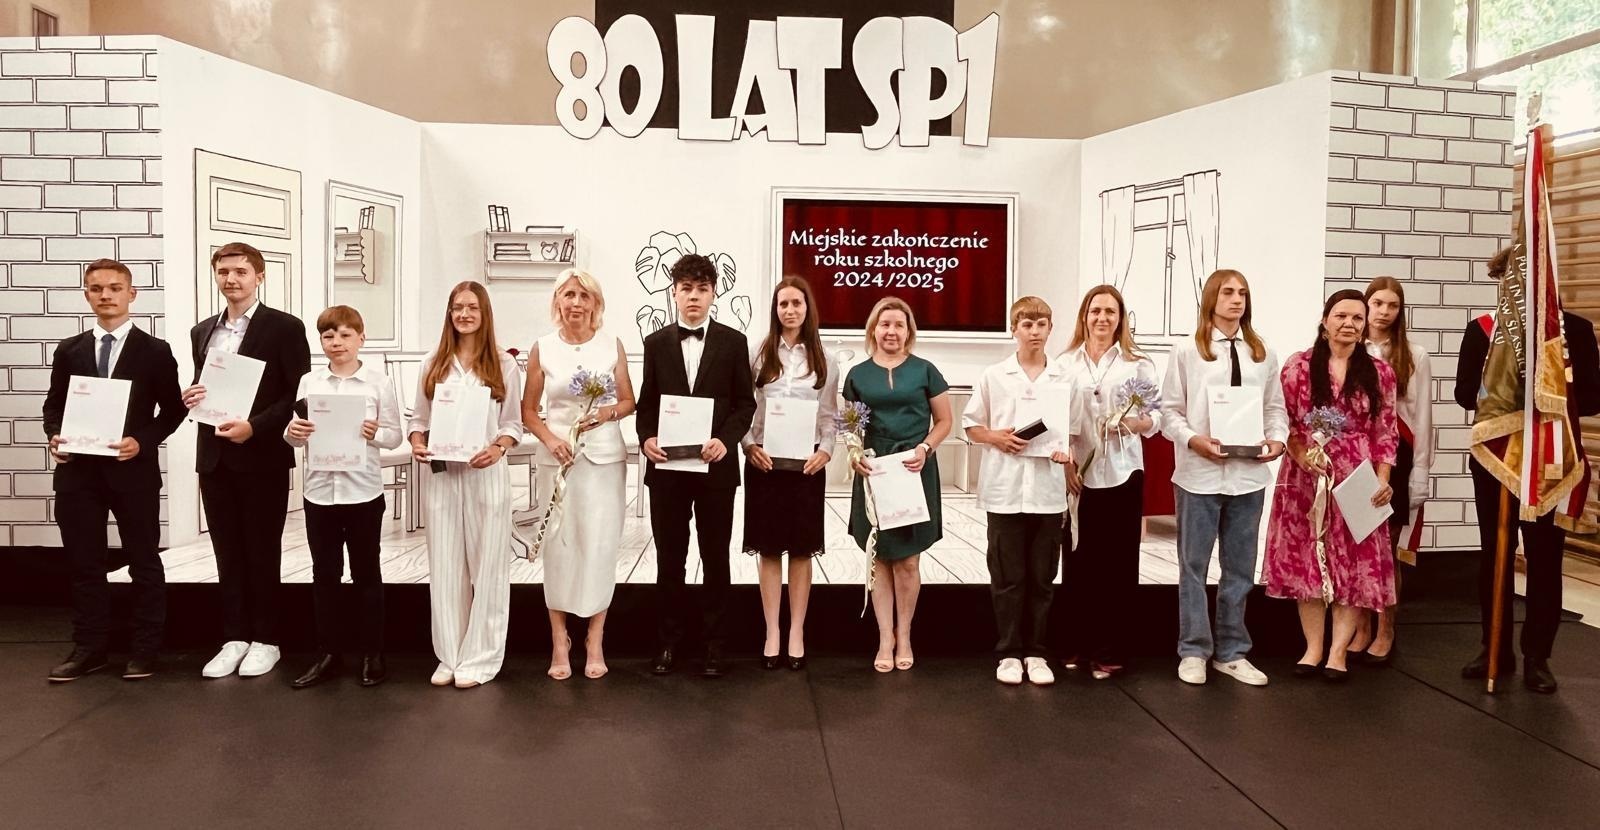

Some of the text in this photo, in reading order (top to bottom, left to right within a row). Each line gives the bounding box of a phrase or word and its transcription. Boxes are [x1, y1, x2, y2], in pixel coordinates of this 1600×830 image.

[546, 11, 1001, 150] 80 LAT SP1
[789, 227, 990, 252] Miejskie zakończenie
[814, 248, 960, 274] roku szkolnego
[833, 271, 945, 293] 2024/2025
